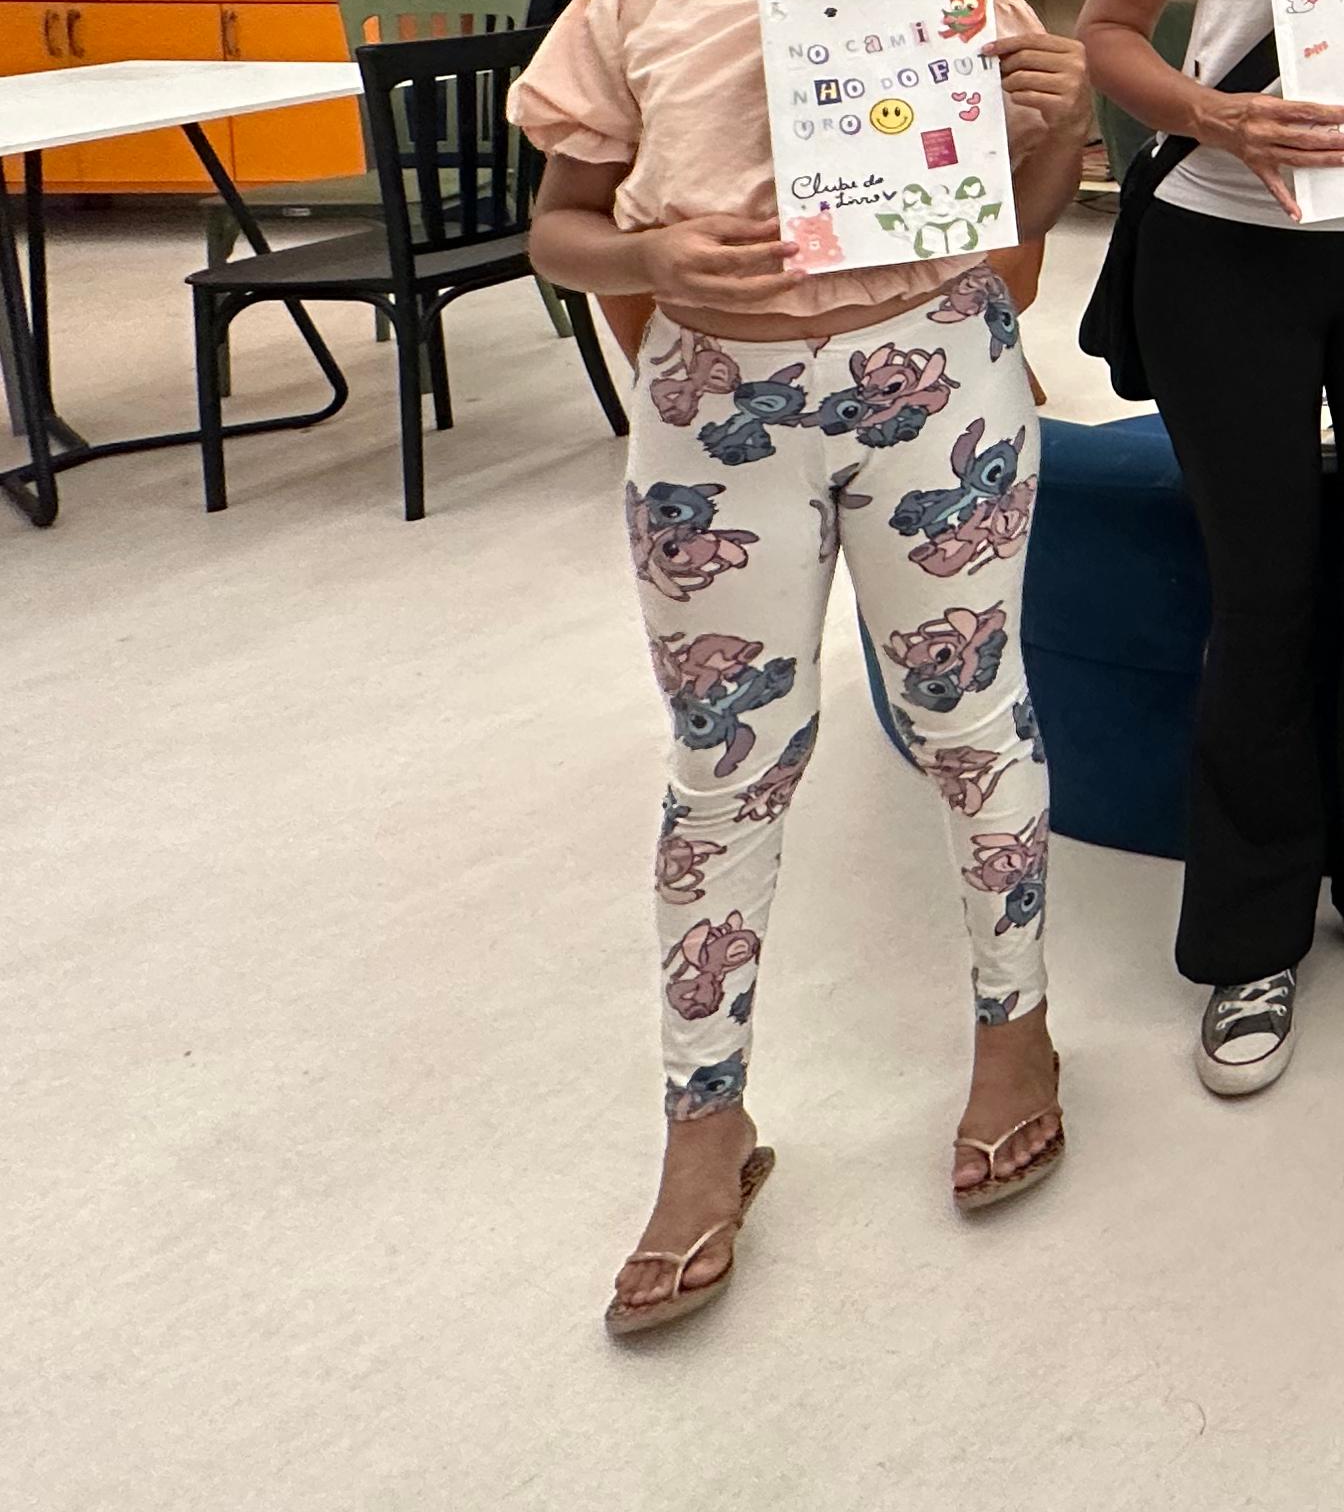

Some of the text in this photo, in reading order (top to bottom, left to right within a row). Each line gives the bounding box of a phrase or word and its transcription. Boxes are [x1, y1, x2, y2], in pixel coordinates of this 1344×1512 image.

[791, 172, 884, 199] Clube do
[836, 192, 880, 209] Livro
